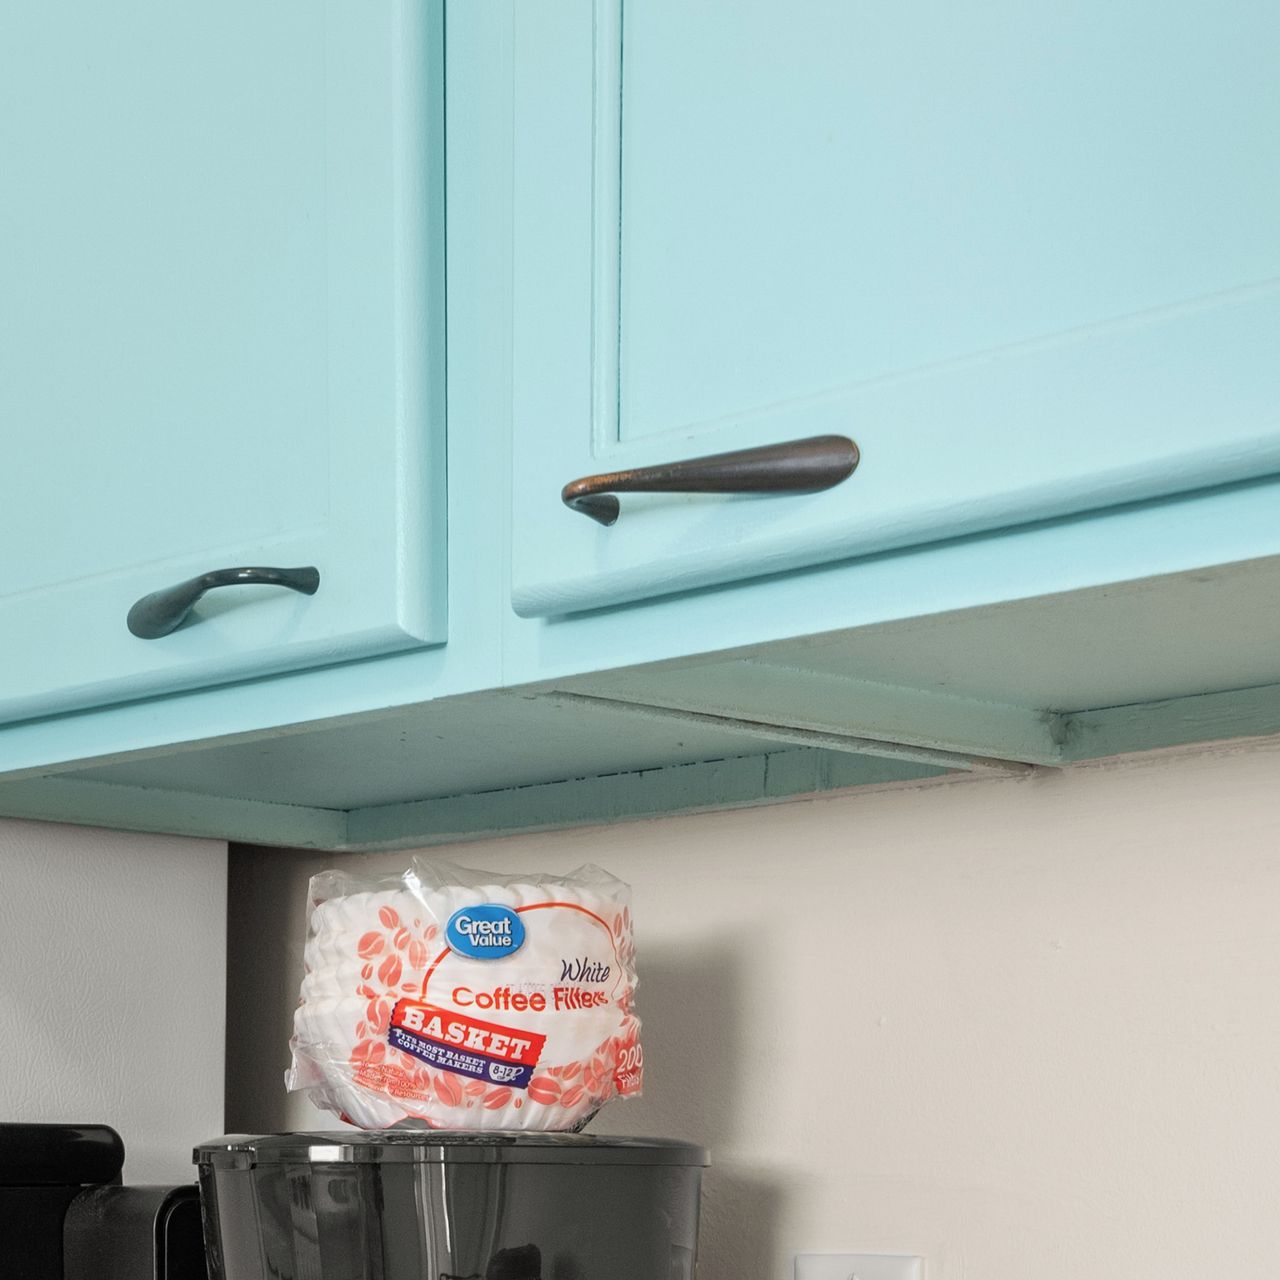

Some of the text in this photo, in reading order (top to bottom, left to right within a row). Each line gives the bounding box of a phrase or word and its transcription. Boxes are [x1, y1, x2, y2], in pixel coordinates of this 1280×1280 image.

[455, 915, 511, 935] Great
[469, 934, 512, 947] Value
[560, 956, 611, 982] White
[452, 986, 609, 1012] Coffee Filters
[401, 1006, 531, 1060] BASKET
[392, 1028, 486, 1067] FITS MOST BASKET
[397, 1038, 484, 1074] COFFEE MAKERS
[617, 1043, 643, 1073] 200
[493, 1065, 514, 1077] 8-12
